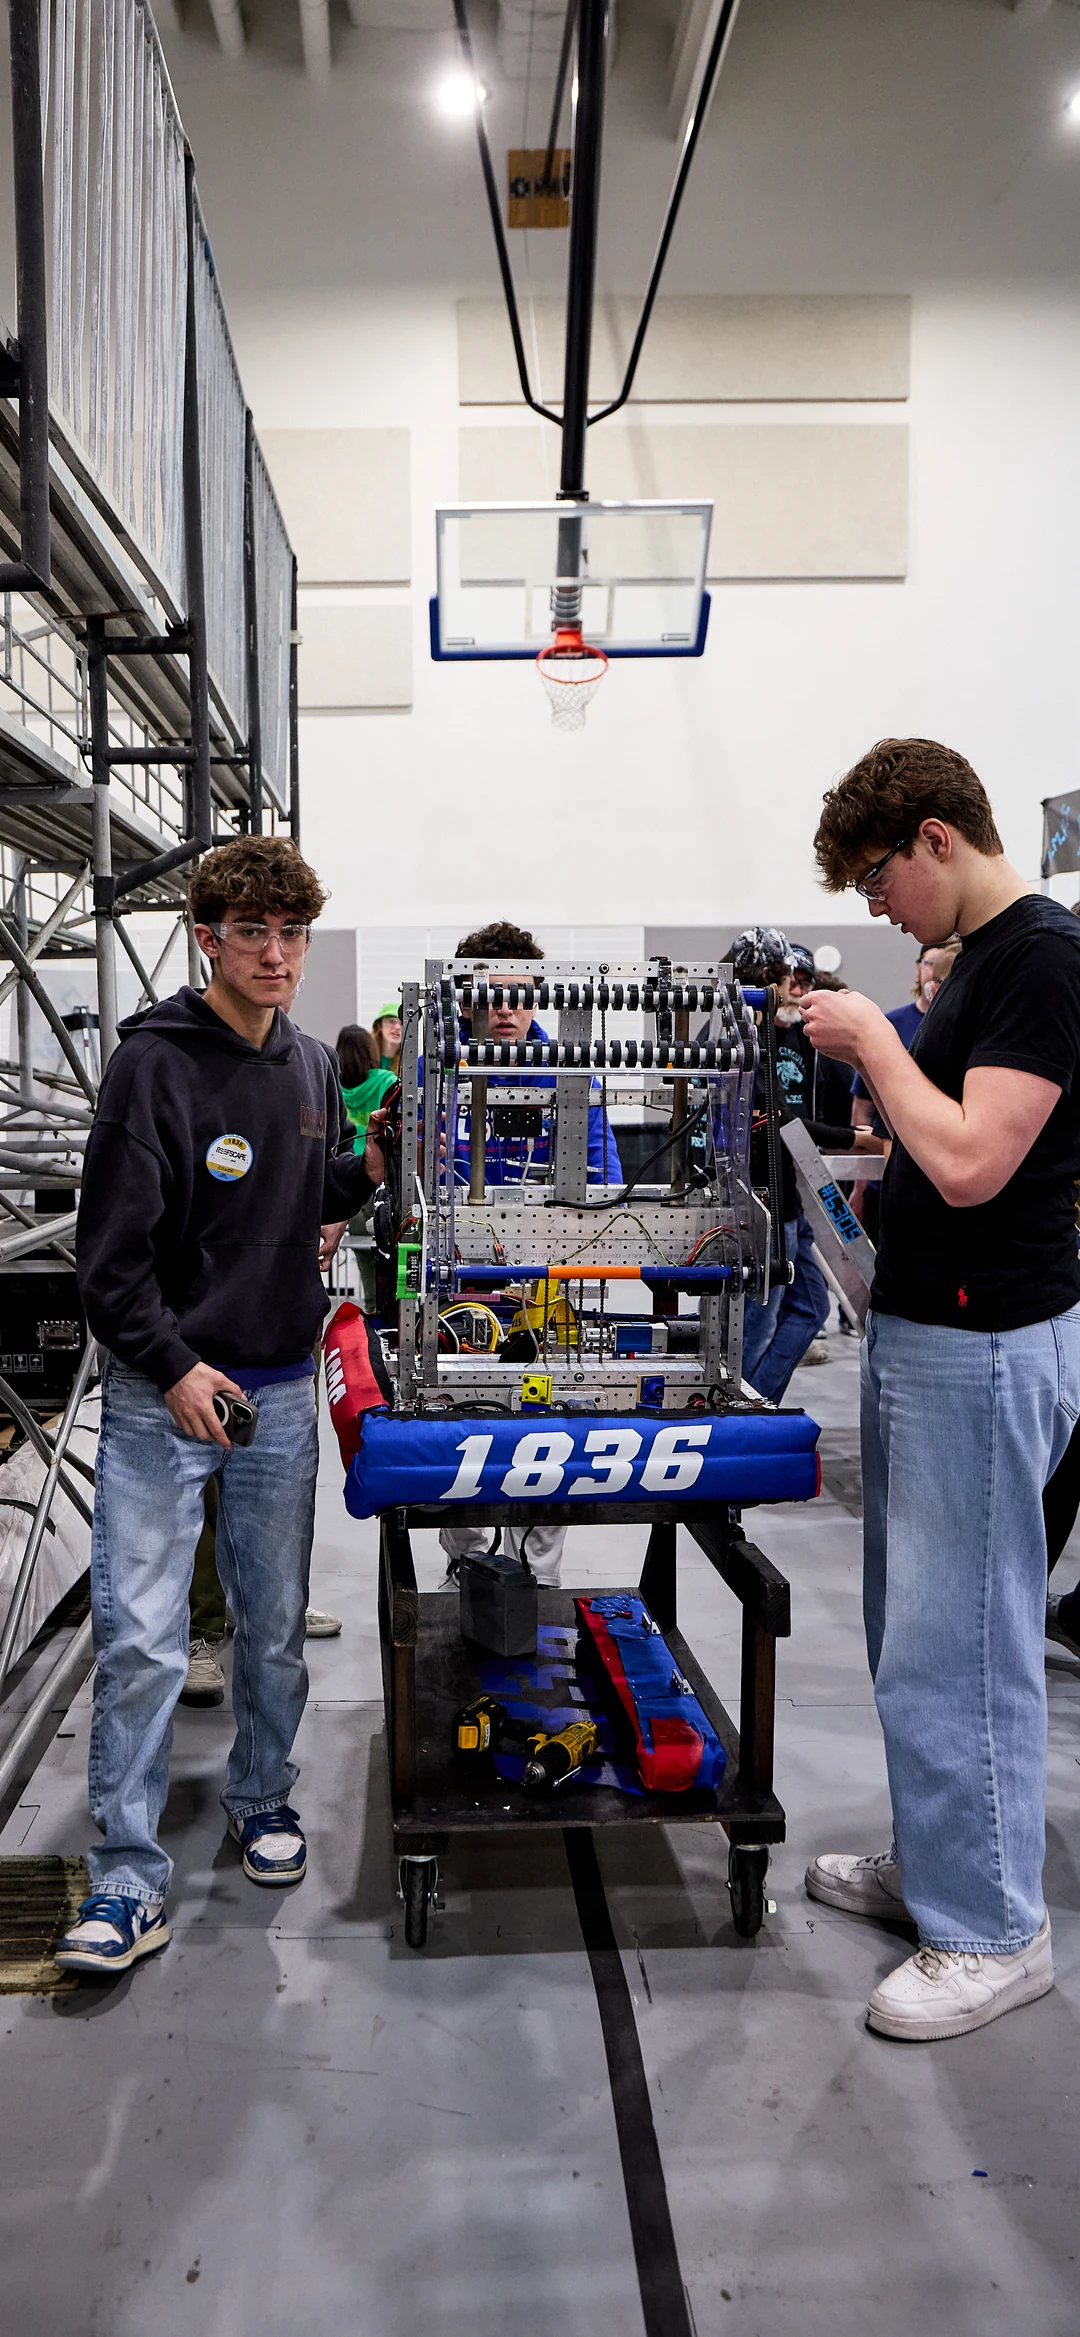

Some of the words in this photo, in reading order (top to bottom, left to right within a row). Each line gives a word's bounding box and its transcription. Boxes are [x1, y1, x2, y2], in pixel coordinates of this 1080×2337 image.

[216, 1146, 247, 1162] REEFSCAPE
[820, 1184, 862, 1243] #6305
[439, 1424, 713, 1499] 1836
